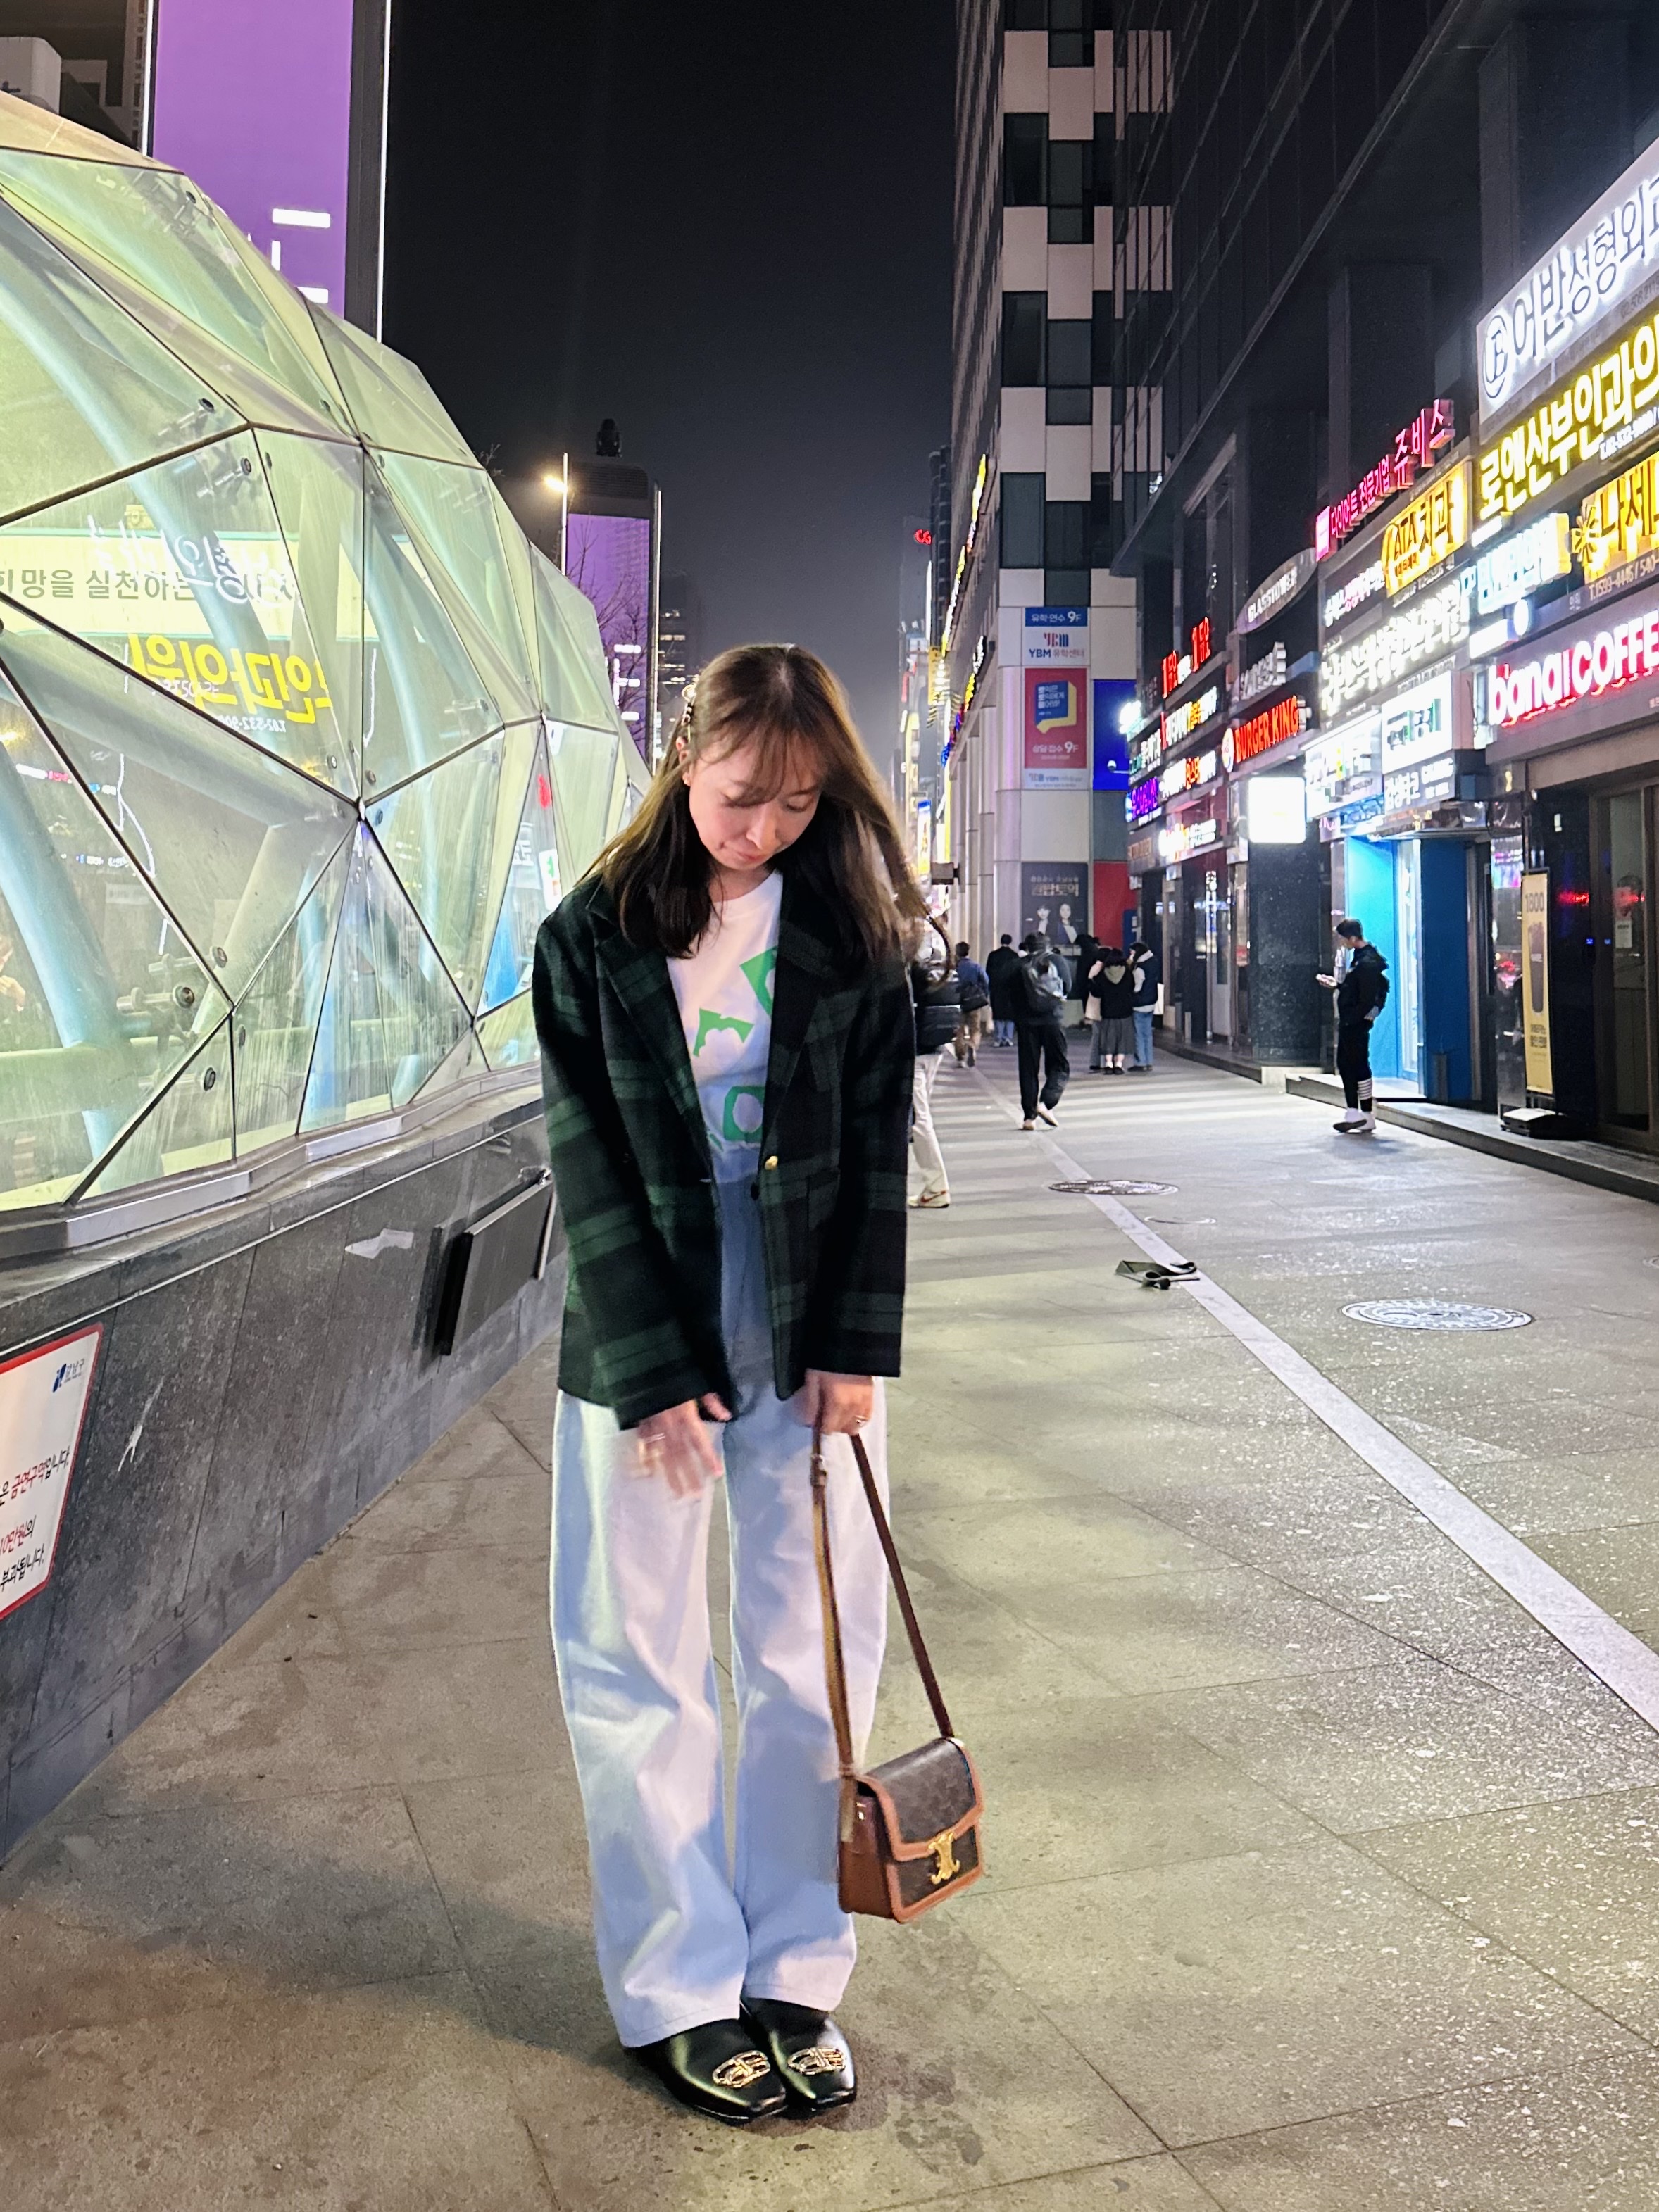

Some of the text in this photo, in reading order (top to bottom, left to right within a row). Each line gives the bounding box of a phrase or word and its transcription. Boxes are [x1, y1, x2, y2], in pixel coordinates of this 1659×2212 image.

[1029, 648, 1051, 658] YBM
[1235, 711, 1269, 763] BURGER
[1272, 695, 1299, 743] KING
